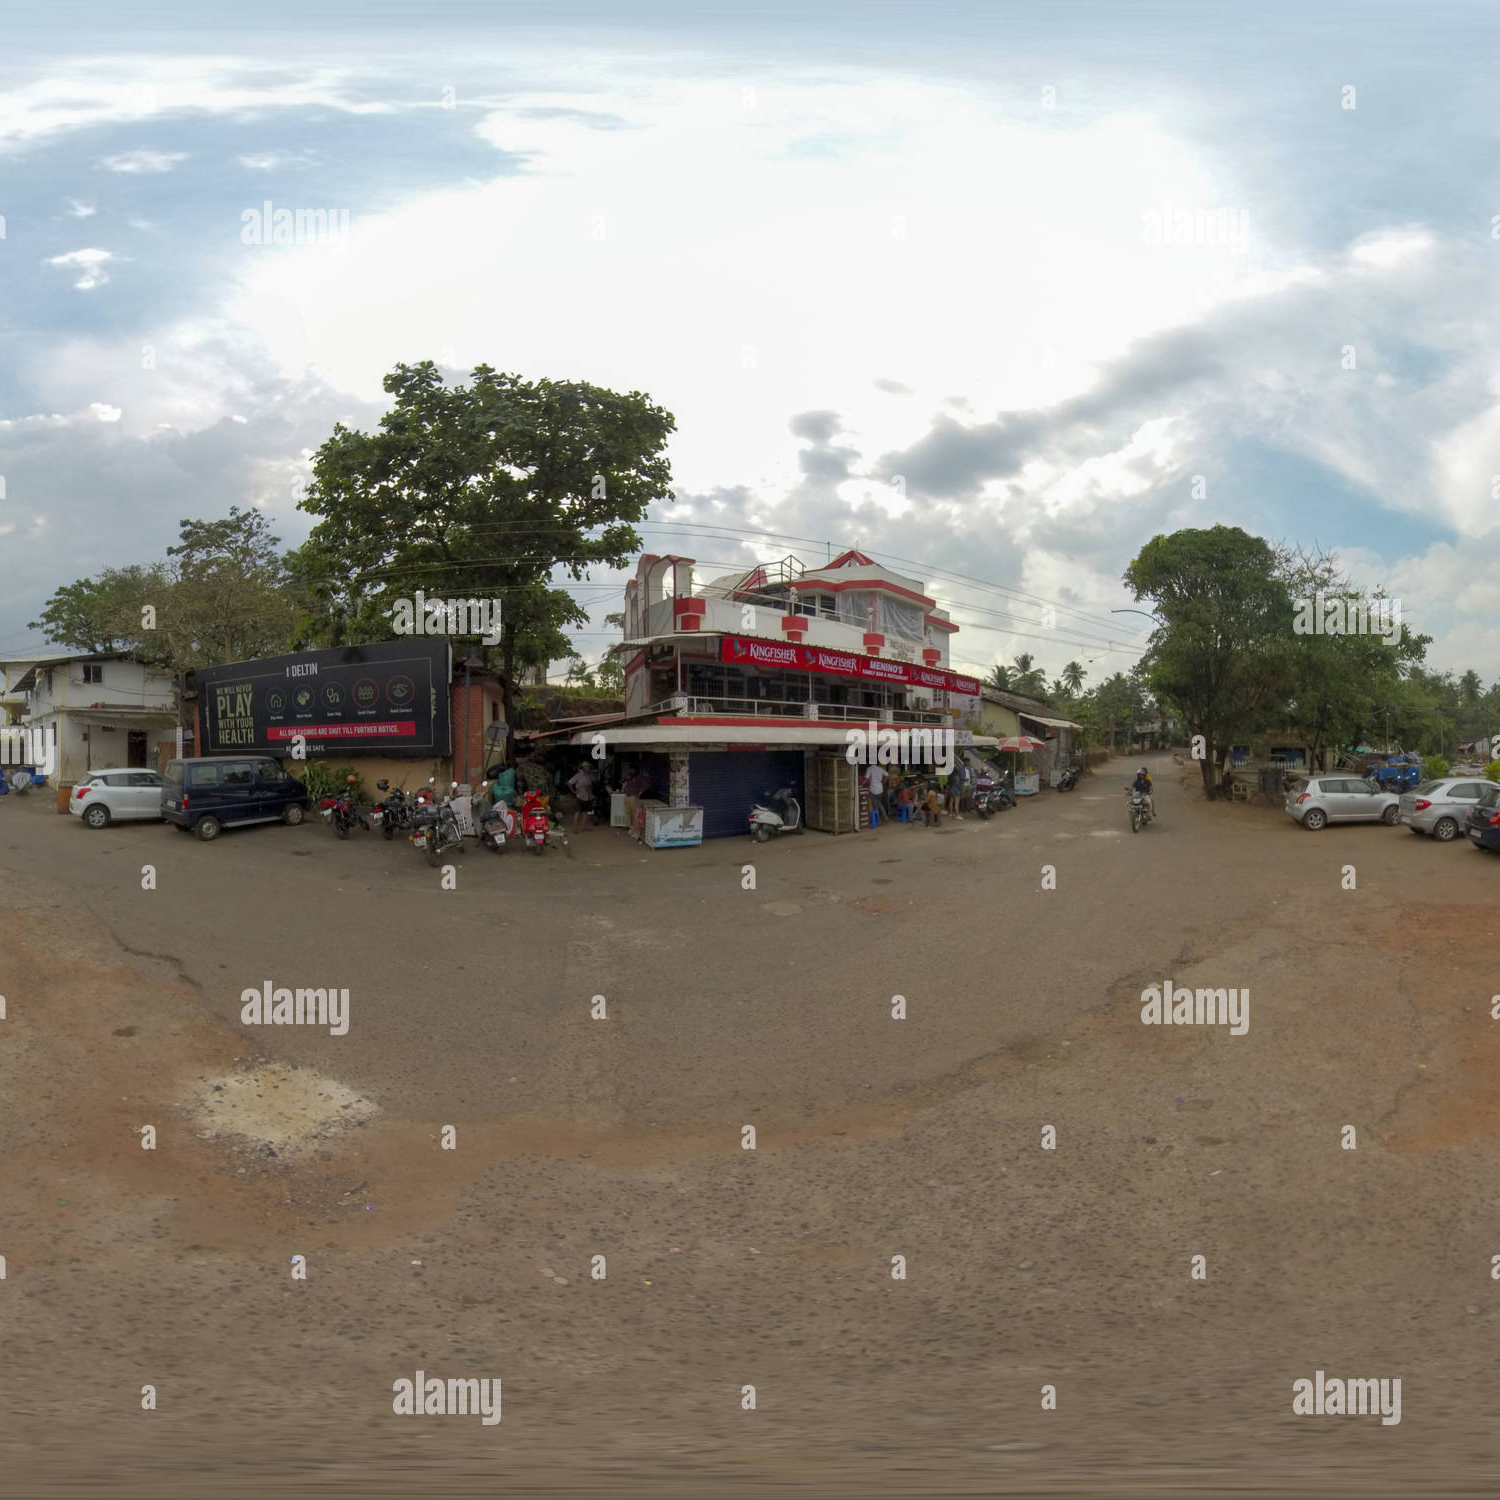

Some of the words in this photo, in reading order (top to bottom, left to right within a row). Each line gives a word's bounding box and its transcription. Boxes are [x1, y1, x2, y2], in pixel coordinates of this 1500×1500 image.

[750, 643, 797, 663] KINGFISHER
[292, 662, 318, 677] DELTIN
[819, 653, 857, 672] KINGFISHER
[870, 660, 903, 675] MENINO'S
[921, 671, 946, 686] KINGFISHER
[235, 684, 252, 693] NEVER
[217, 692, 253, 718] PLAY
[217, 718, 235, 729] WITH
[235, 717, 254, 728] YOUR
[219, 728, 255, 744] HEALTH
[279, 729, 288, 737] ALL
[288, 728, 296, 736] OUR
[297, 728, 317, 736] CASINOS
[318, 727, 328, 736] ARE
[329, 727, 341, 735] SHUT
[343, 726, 353, 734] TILL
[354, 725, 377, 733] FURTHER
